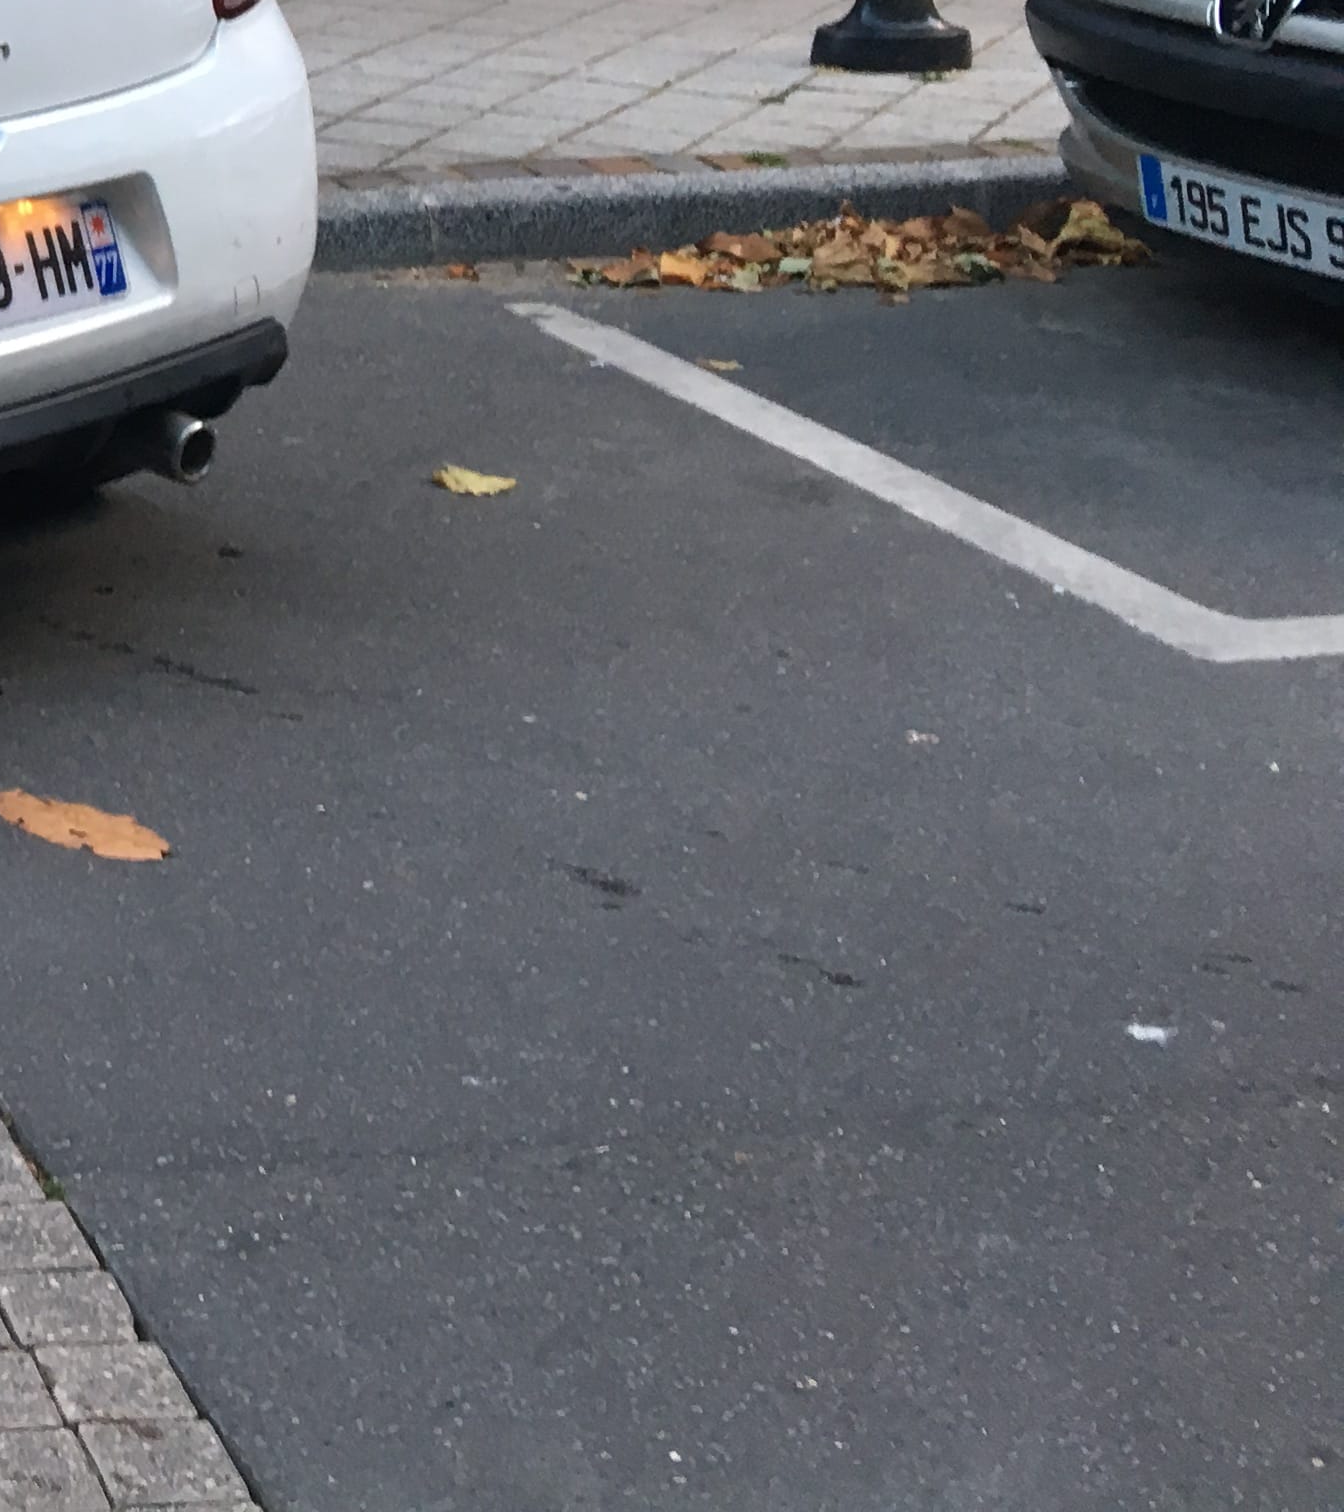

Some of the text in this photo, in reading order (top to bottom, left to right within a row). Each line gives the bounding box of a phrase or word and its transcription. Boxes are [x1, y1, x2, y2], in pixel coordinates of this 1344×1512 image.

[1171, 174, 1230, 237] 195
[1240, 194, 1312, 260] EJS
[94, 250, 120, 287] 77
